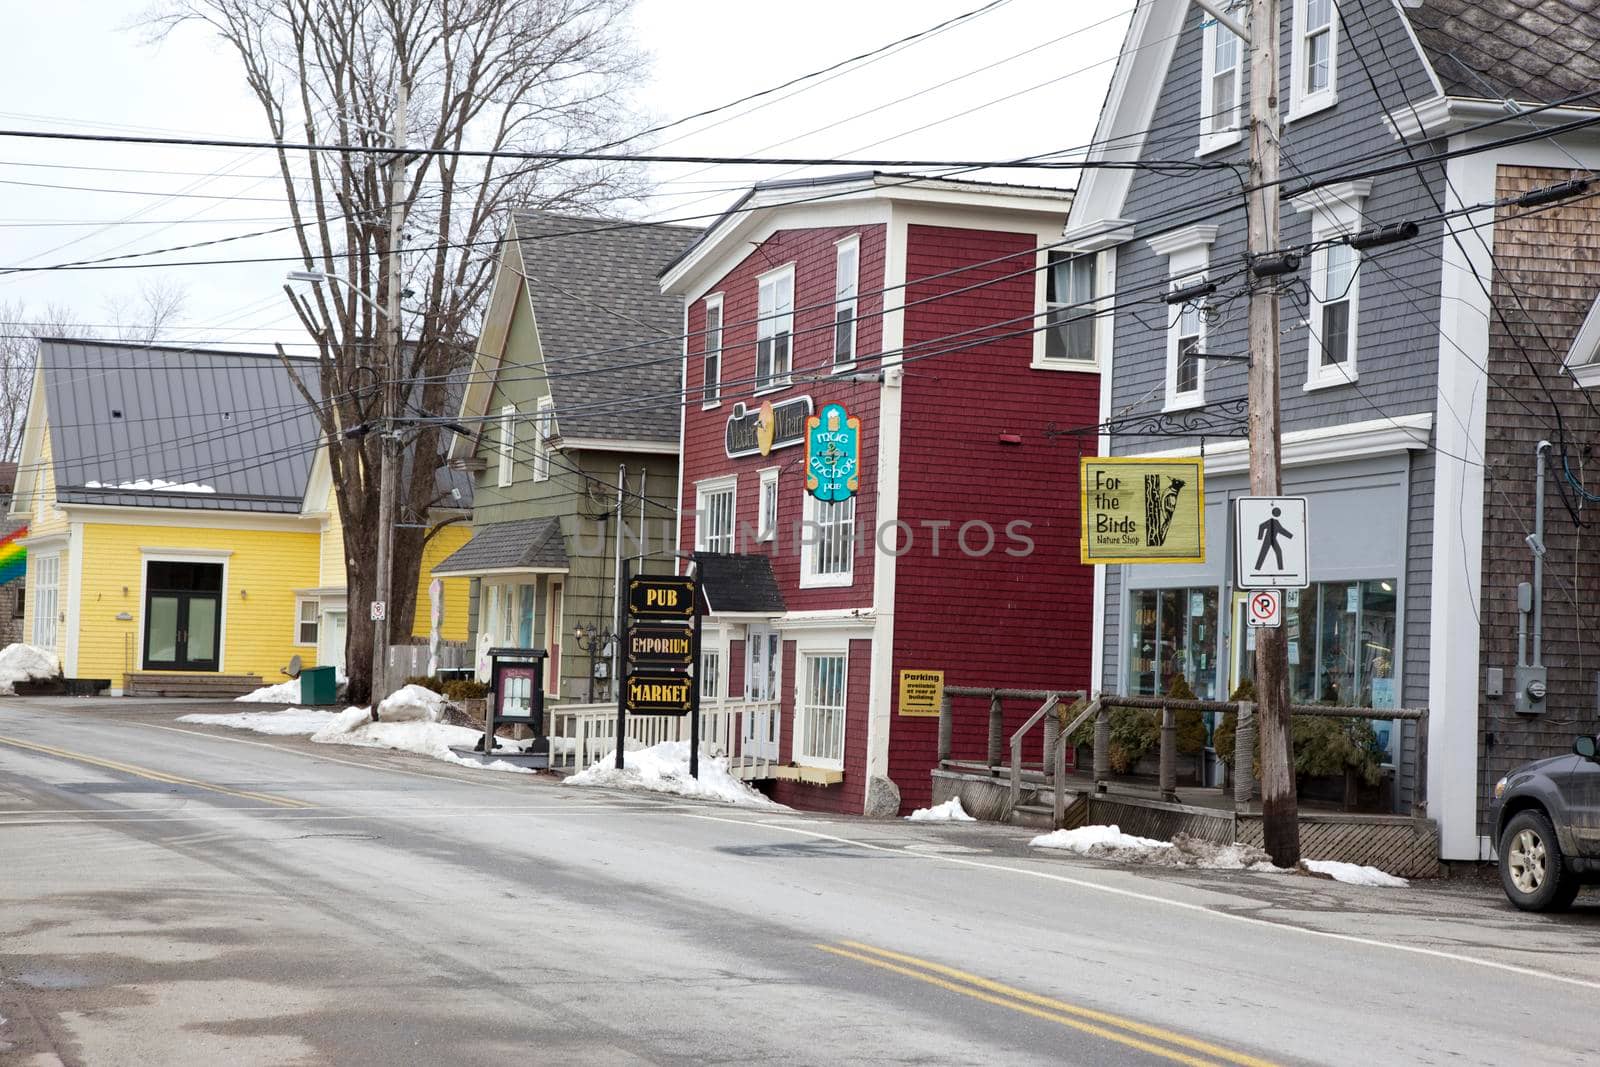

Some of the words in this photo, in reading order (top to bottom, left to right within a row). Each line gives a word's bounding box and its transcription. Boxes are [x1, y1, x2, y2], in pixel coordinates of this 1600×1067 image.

[1096, 471, 1121, 490] For
[1095, 492, 1120, 510] the
[1096, 513, 1136, 533] Birds
[1097, 535, 1120, 544] Nature
[1122, 534, 1140, 546] Shop
[646, 589, 678, 606] PUB
[632, 637, 688, 653] EMPORIUM
[904, 674, 940, 682] Parking
[631, 684, 688, 702] MARKET
